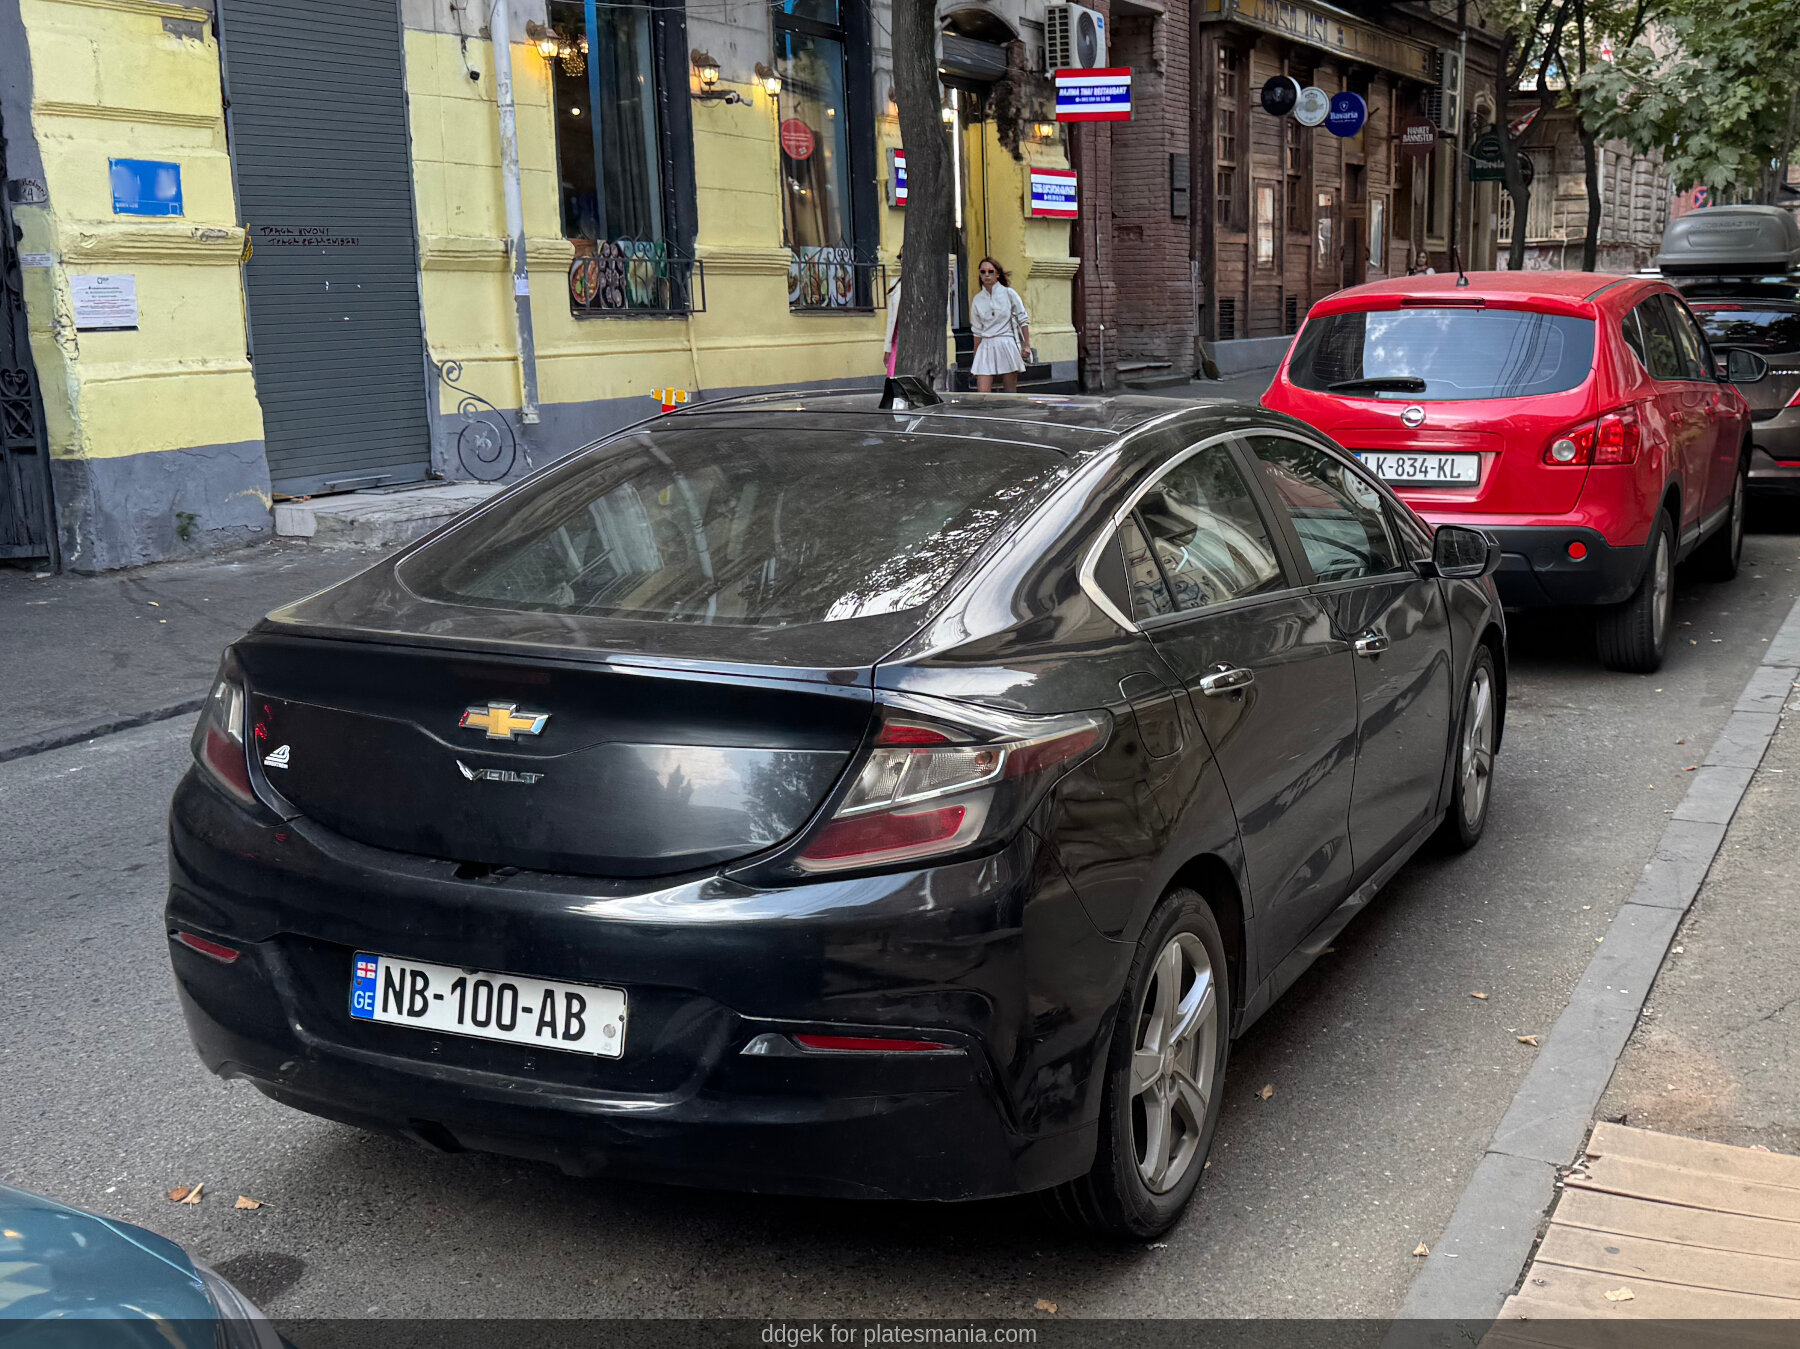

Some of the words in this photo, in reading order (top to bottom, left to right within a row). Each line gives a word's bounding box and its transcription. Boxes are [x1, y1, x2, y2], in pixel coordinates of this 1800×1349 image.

[1330, 111, 1358, 120] Bavaria
[1407, 126, 1430, 134] HANKEY
[1402, 134, 1434, 143] BANNISTER
[456, 759, 545, 784] VOLT
[353, 989, 374, 1011] GE
[381, 964, 588, 1042] NB-100-AB
